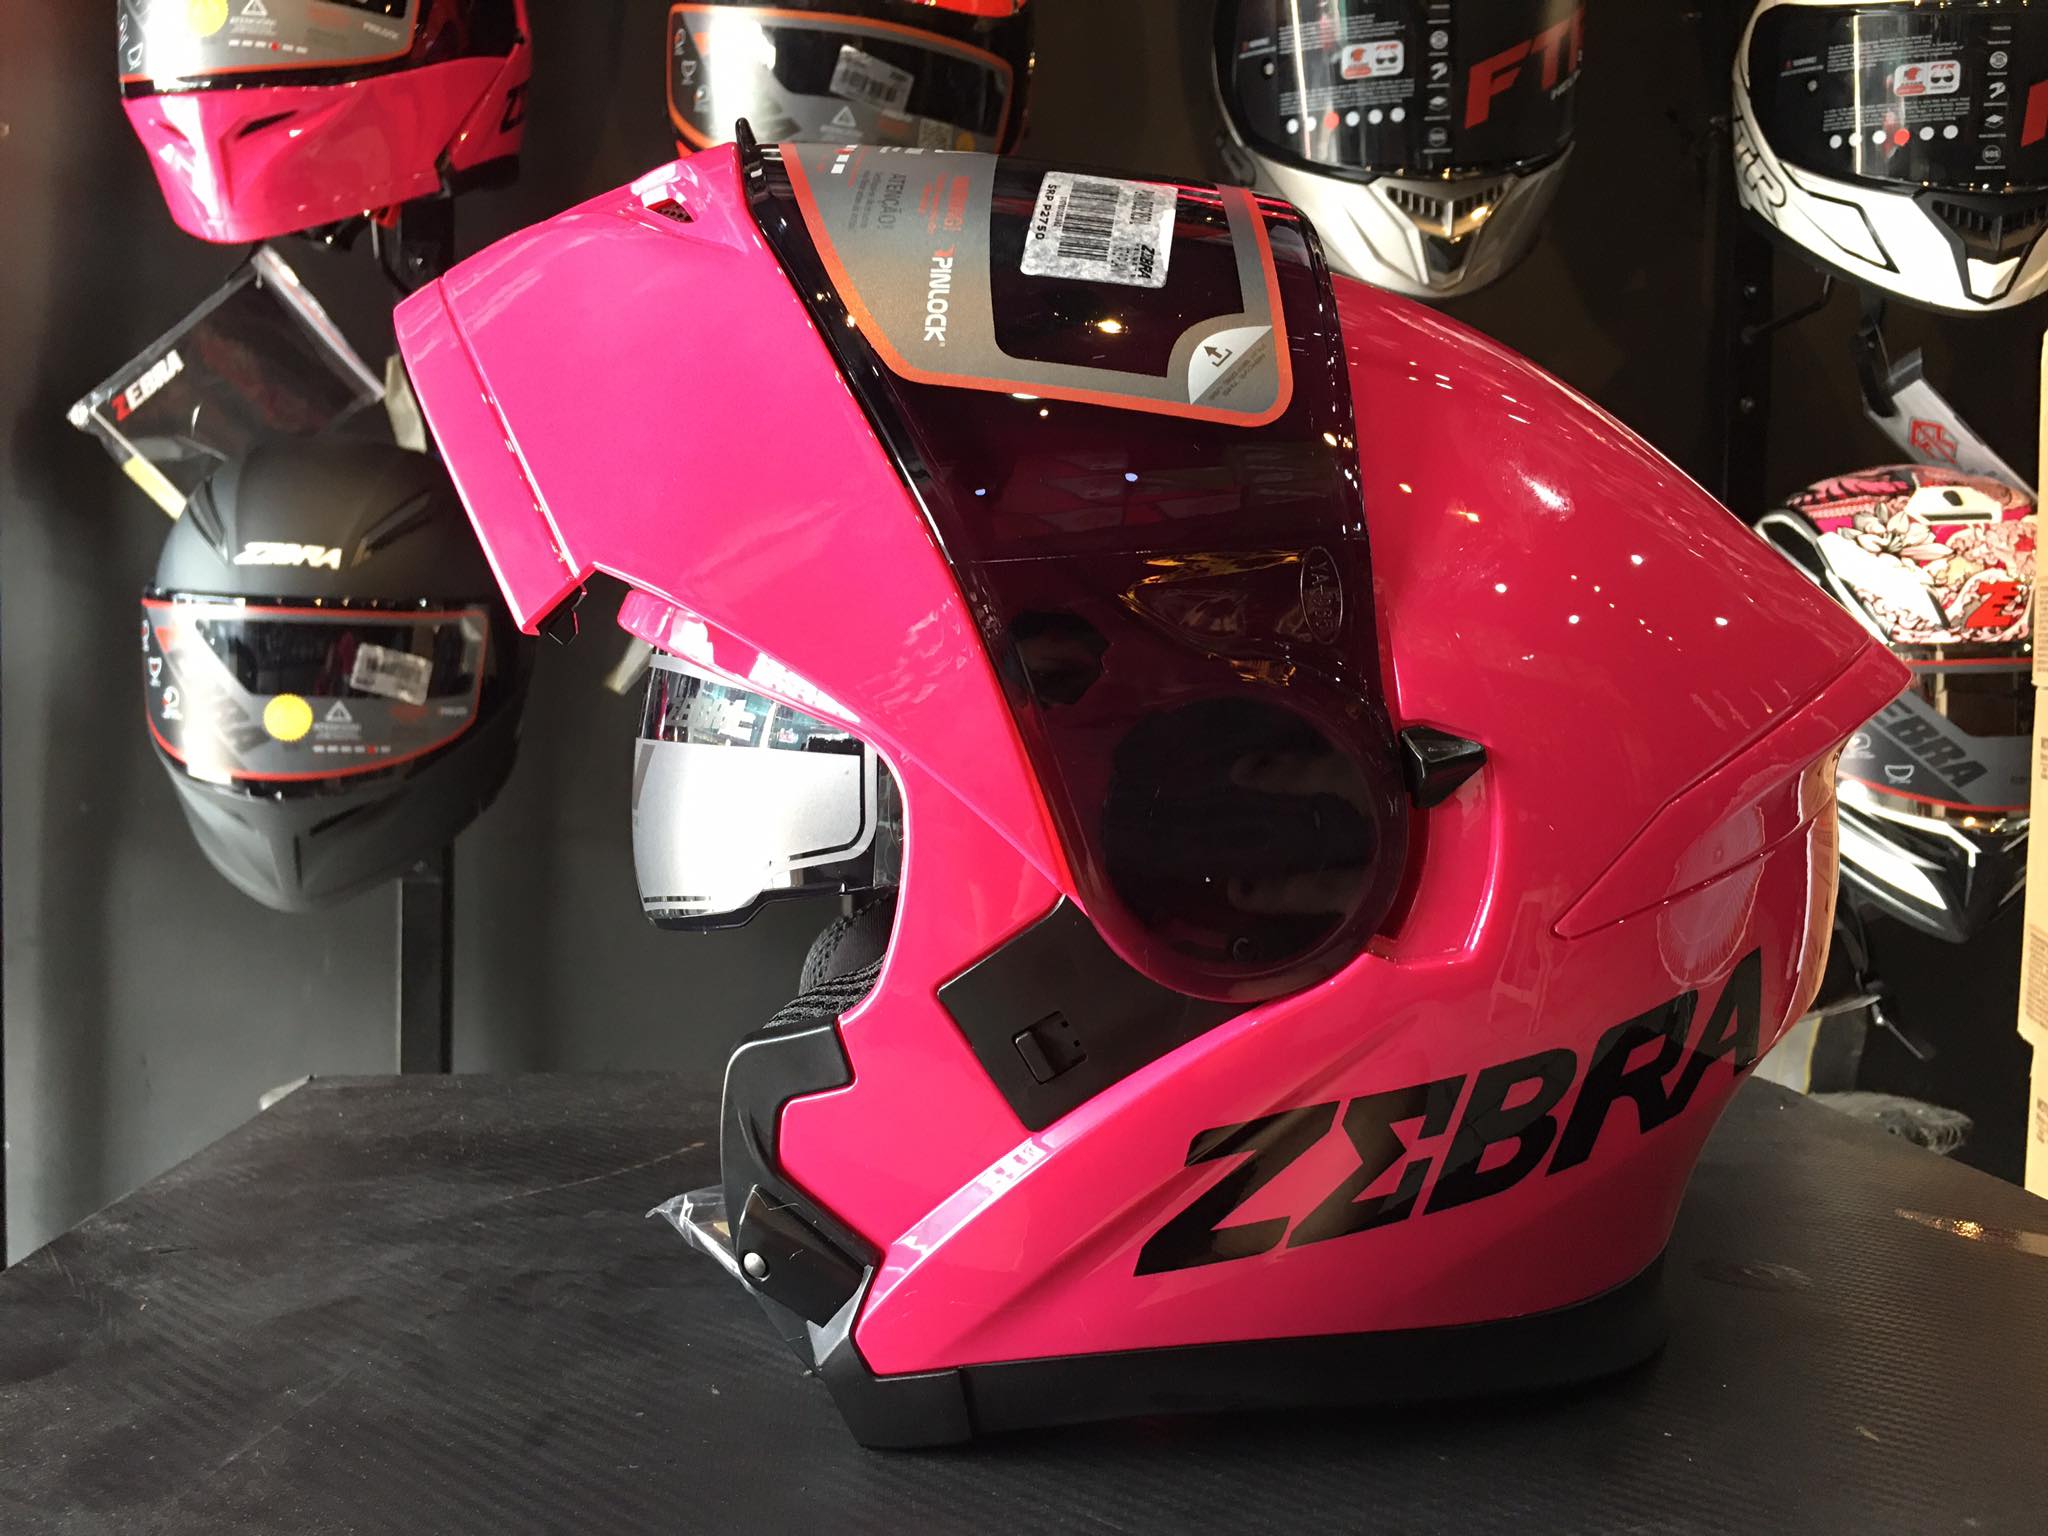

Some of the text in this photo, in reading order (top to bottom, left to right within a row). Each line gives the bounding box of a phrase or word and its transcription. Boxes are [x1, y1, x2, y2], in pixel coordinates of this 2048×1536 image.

[1035, 183, 1057, 240] SRP P2750
[923, 256, 954, 342] PINLOCK
[111, 349, 185, 421] ZEBRA
[1132, 945, 1762, 1278] ZEBRA
